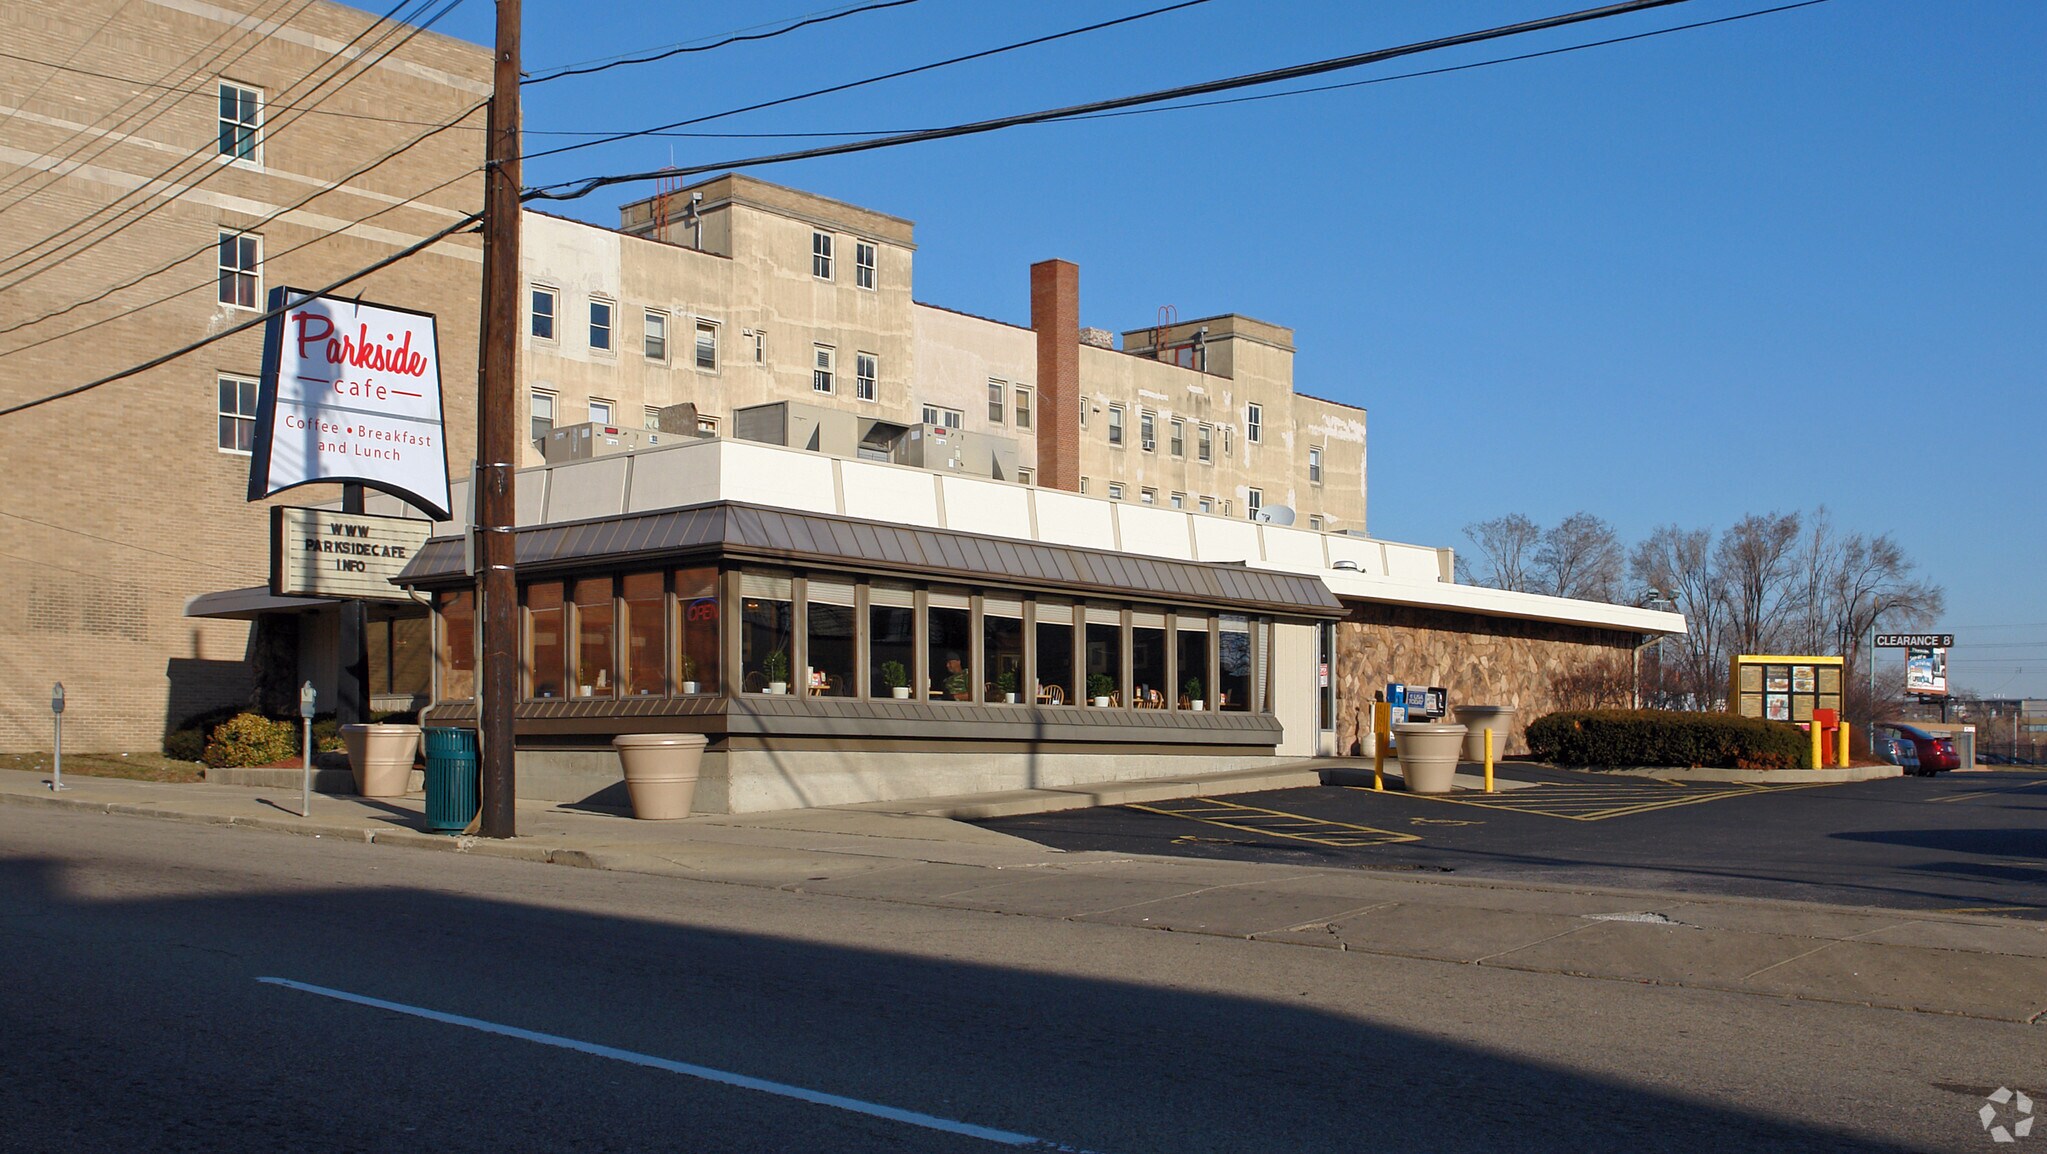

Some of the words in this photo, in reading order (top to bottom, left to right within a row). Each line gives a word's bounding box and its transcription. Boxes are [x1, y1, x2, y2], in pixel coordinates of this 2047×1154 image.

[291, 311, 427, 377] Parkside
[334, 378, 387, 400] cafe
[285, 415, 339, 434] Coffee
[358, 425, 432, 447] Breakfast
[318, 441, 347, 454] and
[355, 444, 401, 461] Lunch
[330, 523, 369, 538] WWW
[305, 539, 406, 559] PARKSIDECAFE
[336, 559, 366, 573] INFO
[1877, 636, 1939, 646] CLEARANCE
